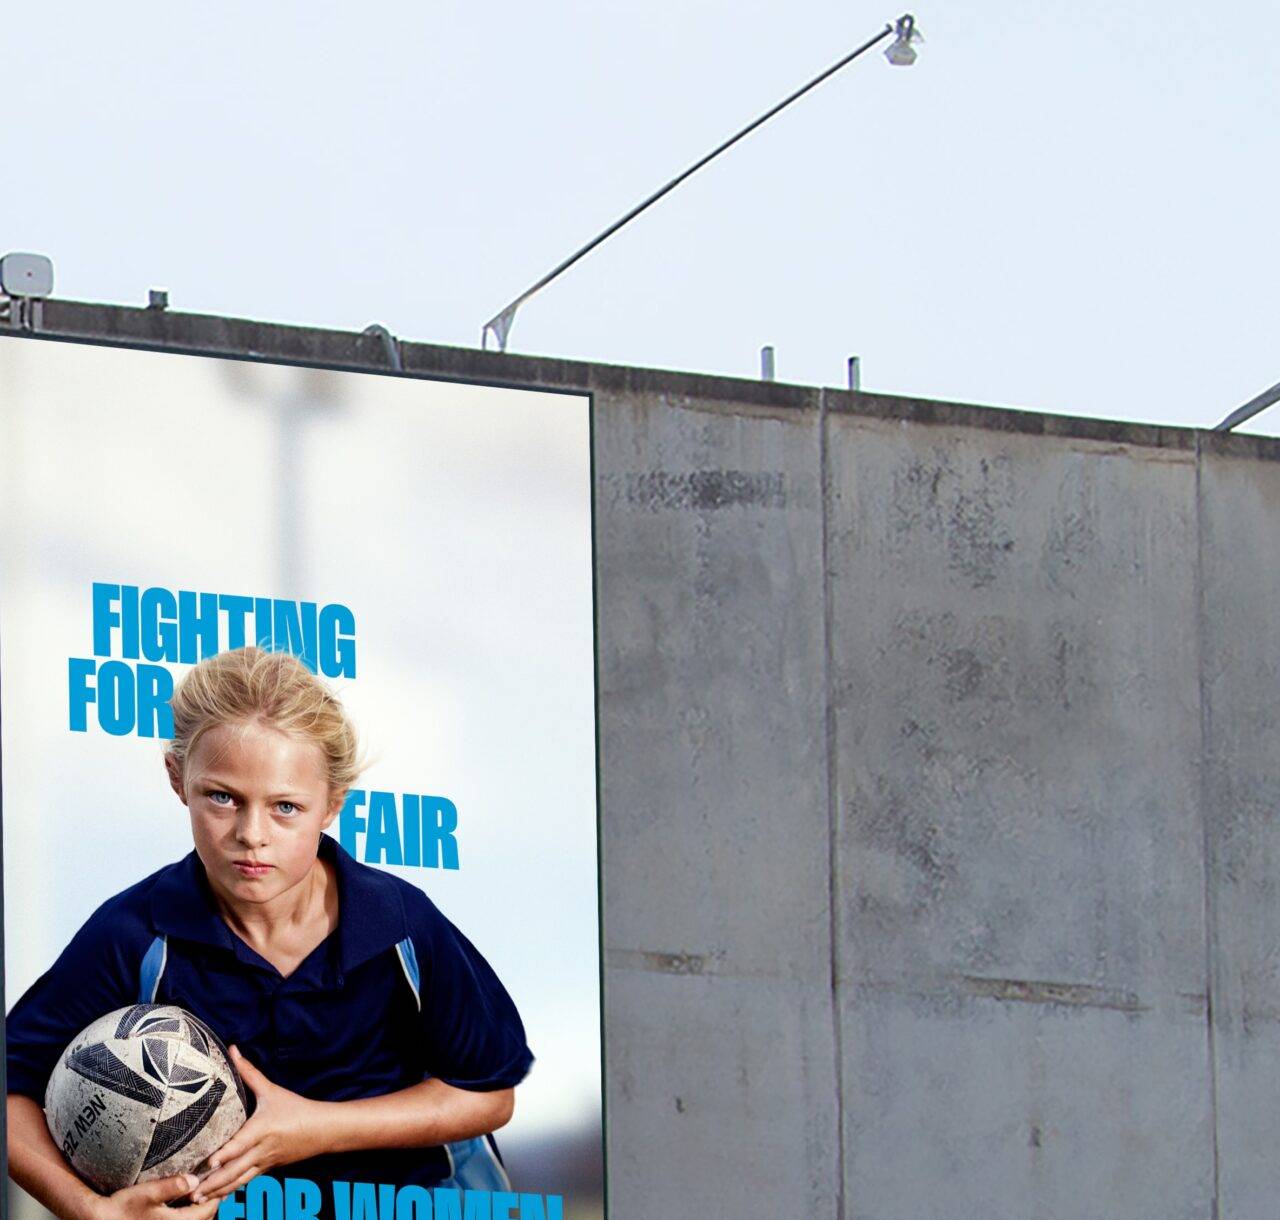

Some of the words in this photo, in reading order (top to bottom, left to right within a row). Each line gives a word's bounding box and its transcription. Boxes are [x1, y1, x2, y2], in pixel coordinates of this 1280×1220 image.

[92, 582, 357, 679] FIGHTING
[68, 657, 176, 740] FOR
[339, 790, 460, 870] FAIR
